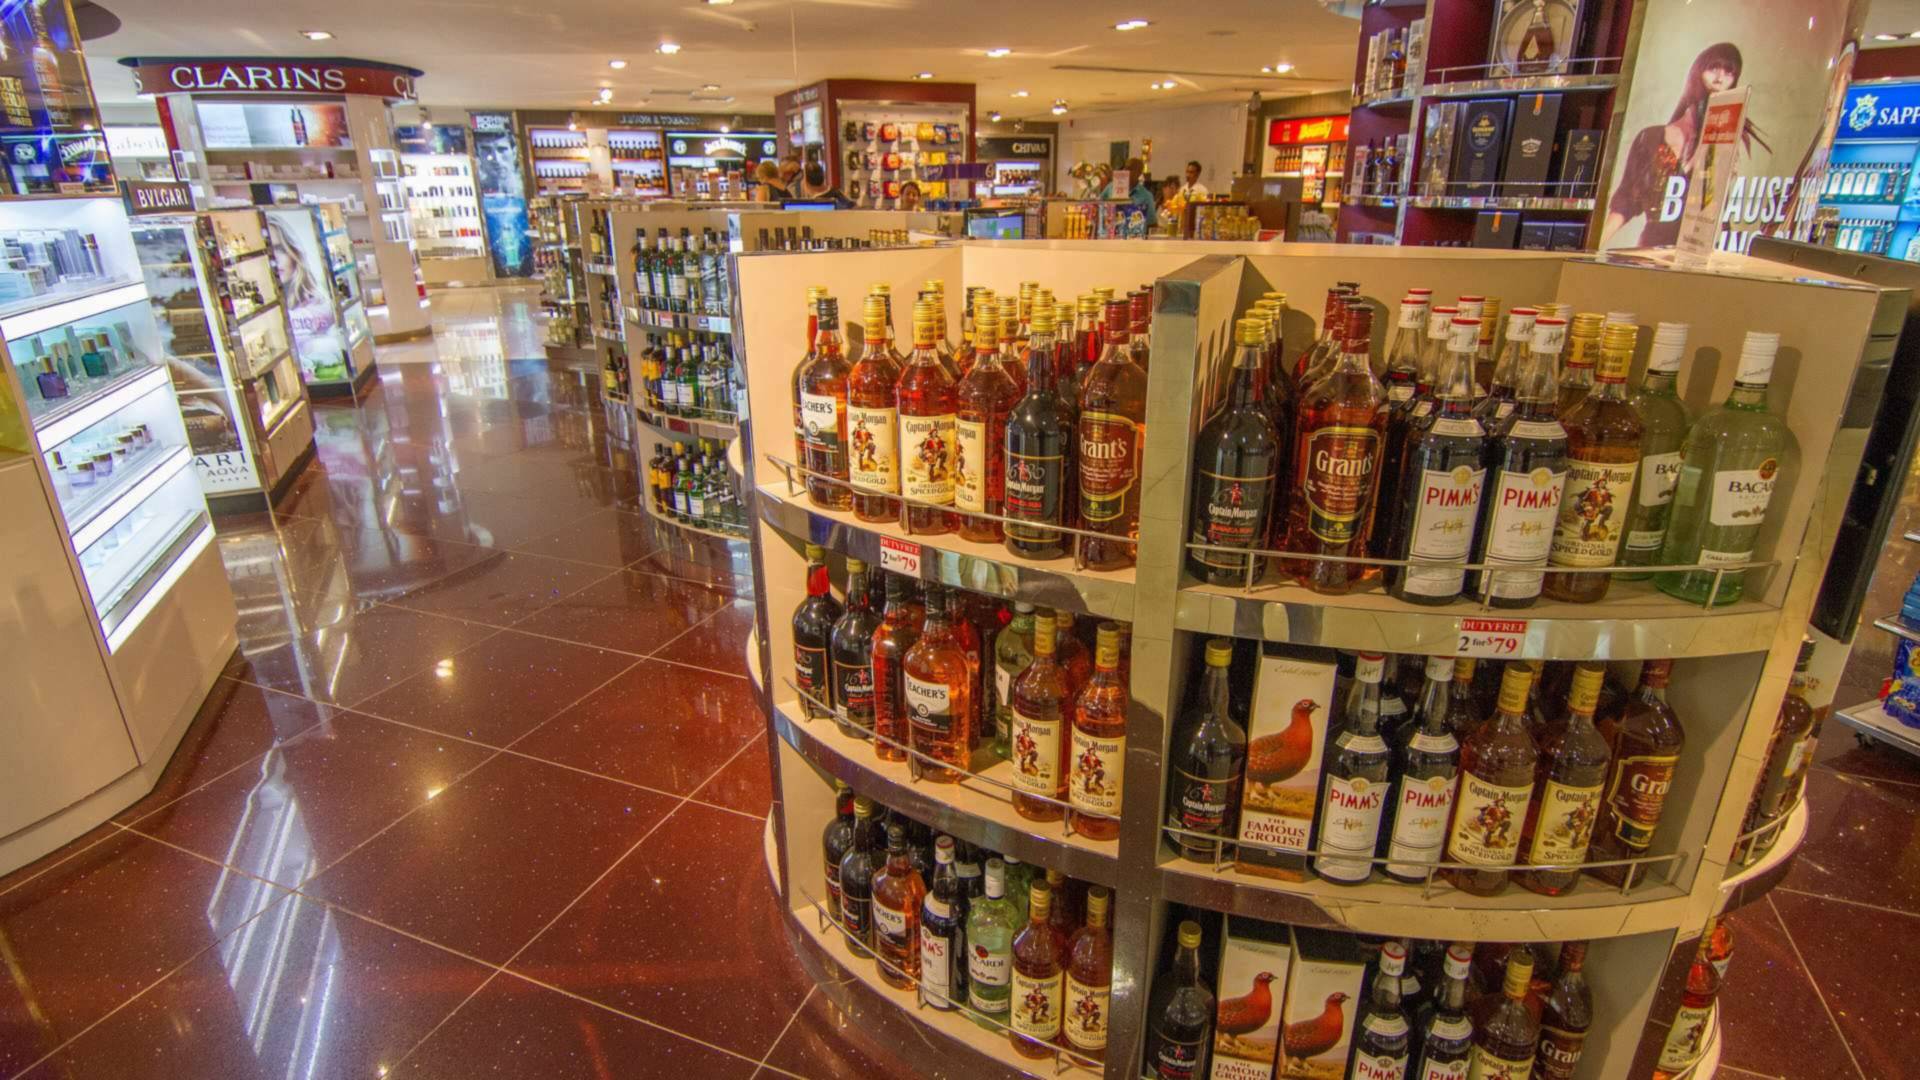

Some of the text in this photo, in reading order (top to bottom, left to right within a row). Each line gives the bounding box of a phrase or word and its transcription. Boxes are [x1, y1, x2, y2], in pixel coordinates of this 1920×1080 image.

[171, 66, 346, 90] CLARINS
[1012, 142, 1047, 154] CHIVAS
[136, 188, 188, 208] BVLGARI
[1316, 450, 1373, 476] Grant's
[1426, 484, 1480, 508] PIMM'S
[1504, 485, 1561, 509] PIMM'S
[881, 551, 889, 565] 2
[1552, 542, 1614, 557] SPICED GOLD
[1458, 636, 1470, 652] 2
[1330, 789, 1380, 810] PIMM'S
[1469, 781, 1497, 800] Captain
[1555, 789, 1588, 803] Captain
[1247, 820, 1305, 838] FAMOUS
[1244, 830, 1305, 848] GROUSE
[1217, 1063, 1268, 1078] FAMOUS
